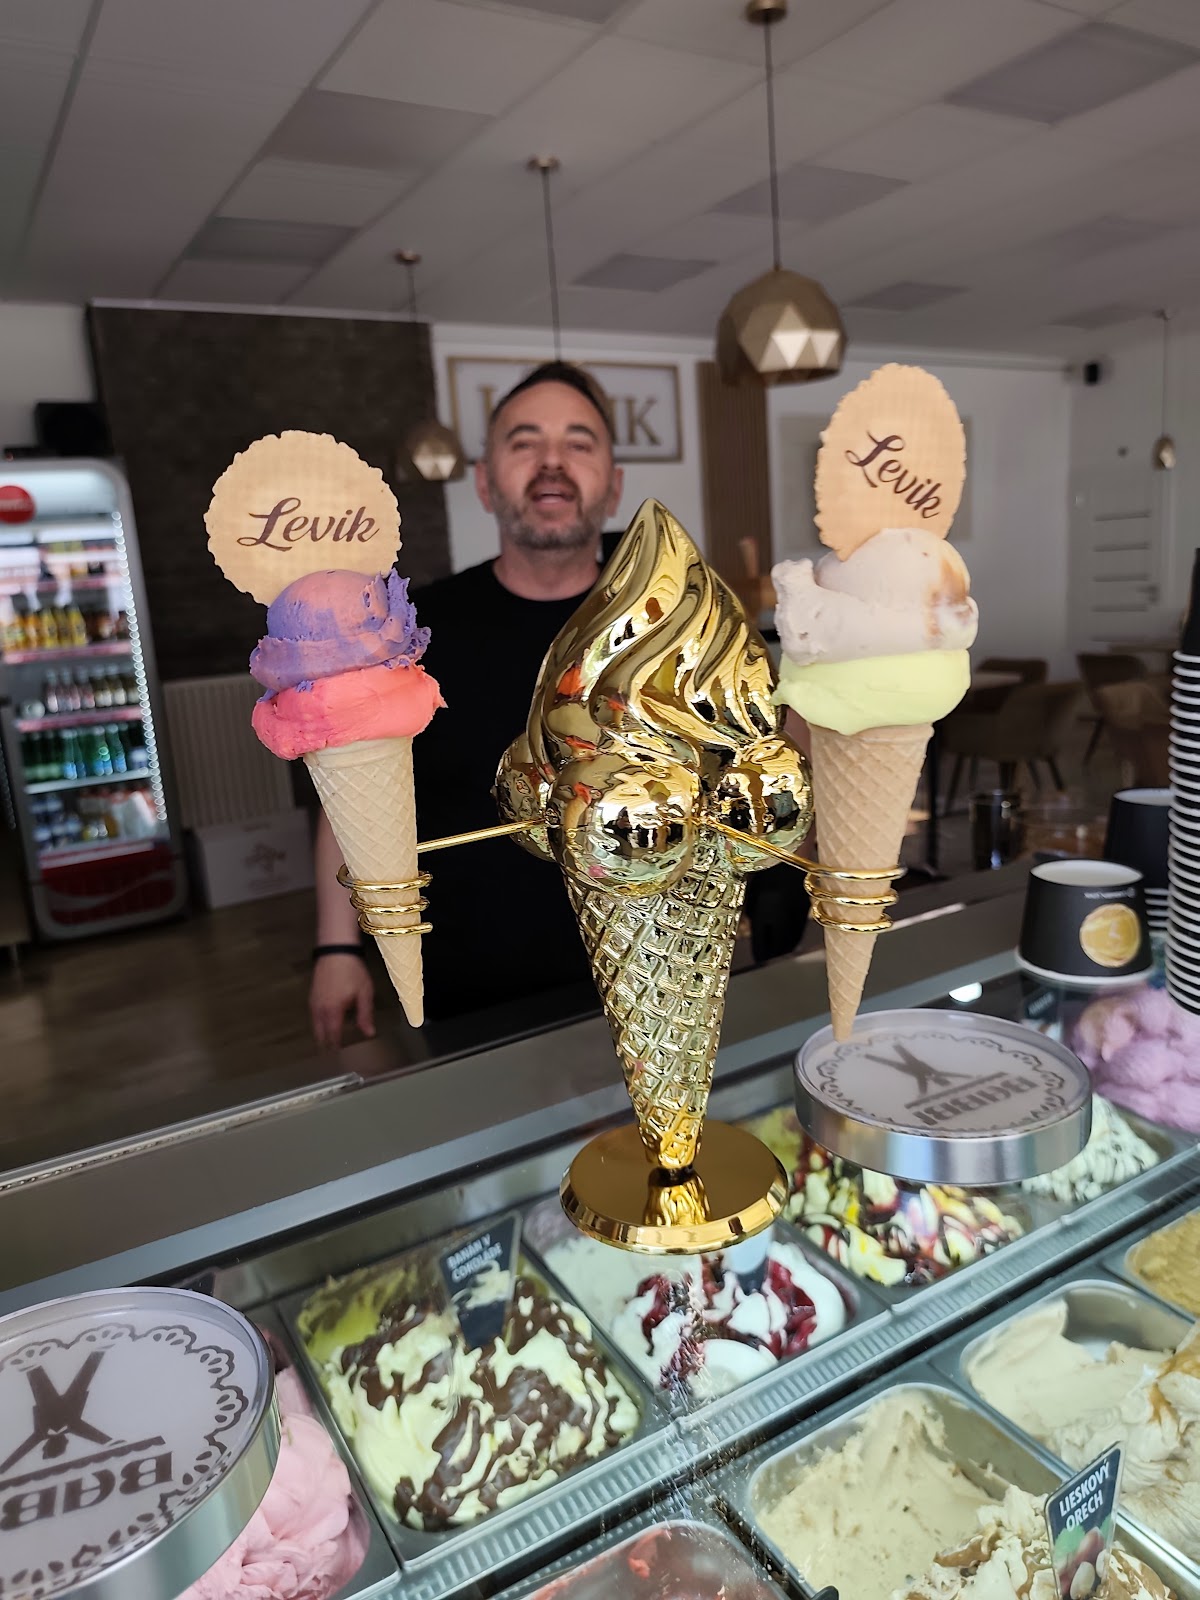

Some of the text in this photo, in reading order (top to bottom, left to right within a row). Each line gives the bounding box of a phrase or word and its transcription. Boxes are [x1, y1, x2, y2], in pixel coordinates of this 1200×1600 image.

[844, 430, 942, 519] Levik
[236, 497, 380, 552] Levik
[1059, 1458, 1109, 1518] LIESKOVÝ
[1066, 1489, 1104, 1532] ORECH
